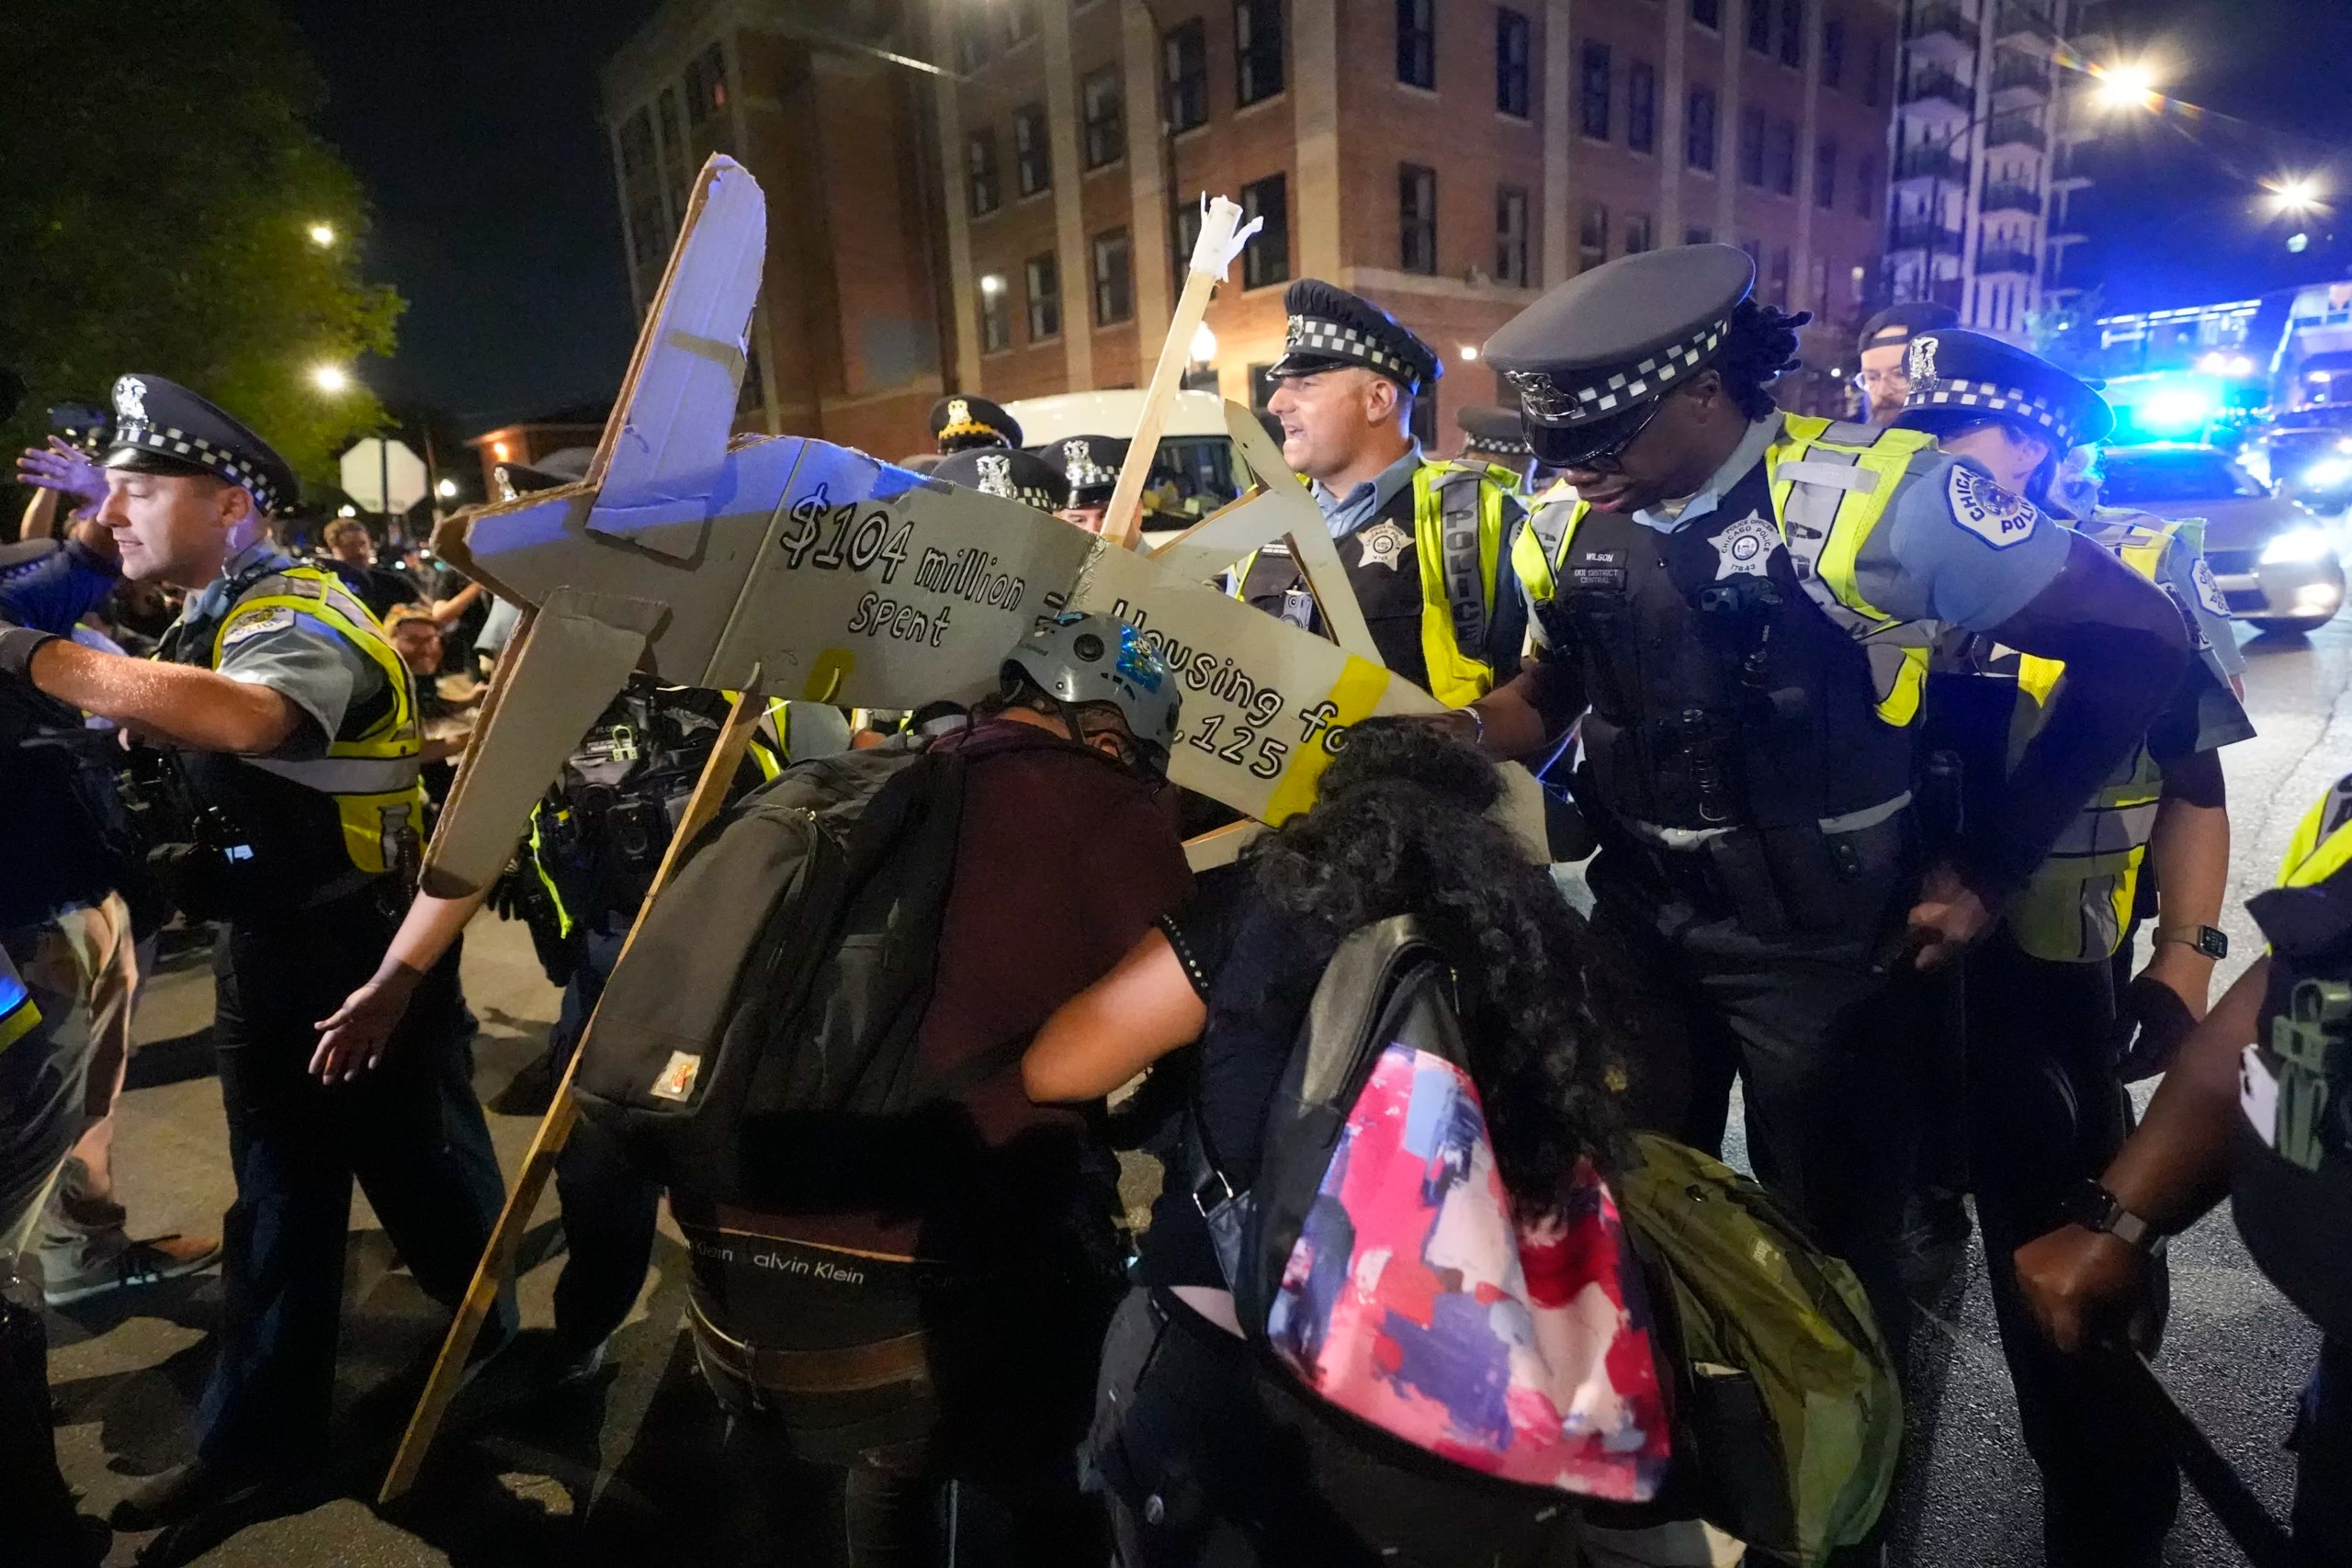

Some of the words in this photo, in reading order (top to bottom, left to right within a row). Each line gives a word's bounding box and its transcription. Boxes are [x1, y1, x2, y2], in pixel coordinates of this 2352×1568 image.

[1956, 470, 1984, 522] CHICA
[2001, 501, 2034, 534] POLI
[779, 482, 915, 584] $104
[914, 547, 1025, 611] million
[1586, 552, 1613, 562] WILSON
[1721, 525, 1752, 554] CHICAGO
[1756, 527, 1771, 552] POLICE
[848, 592, 950, 647] spent
[814, 1261, 865, 1284] Klein
